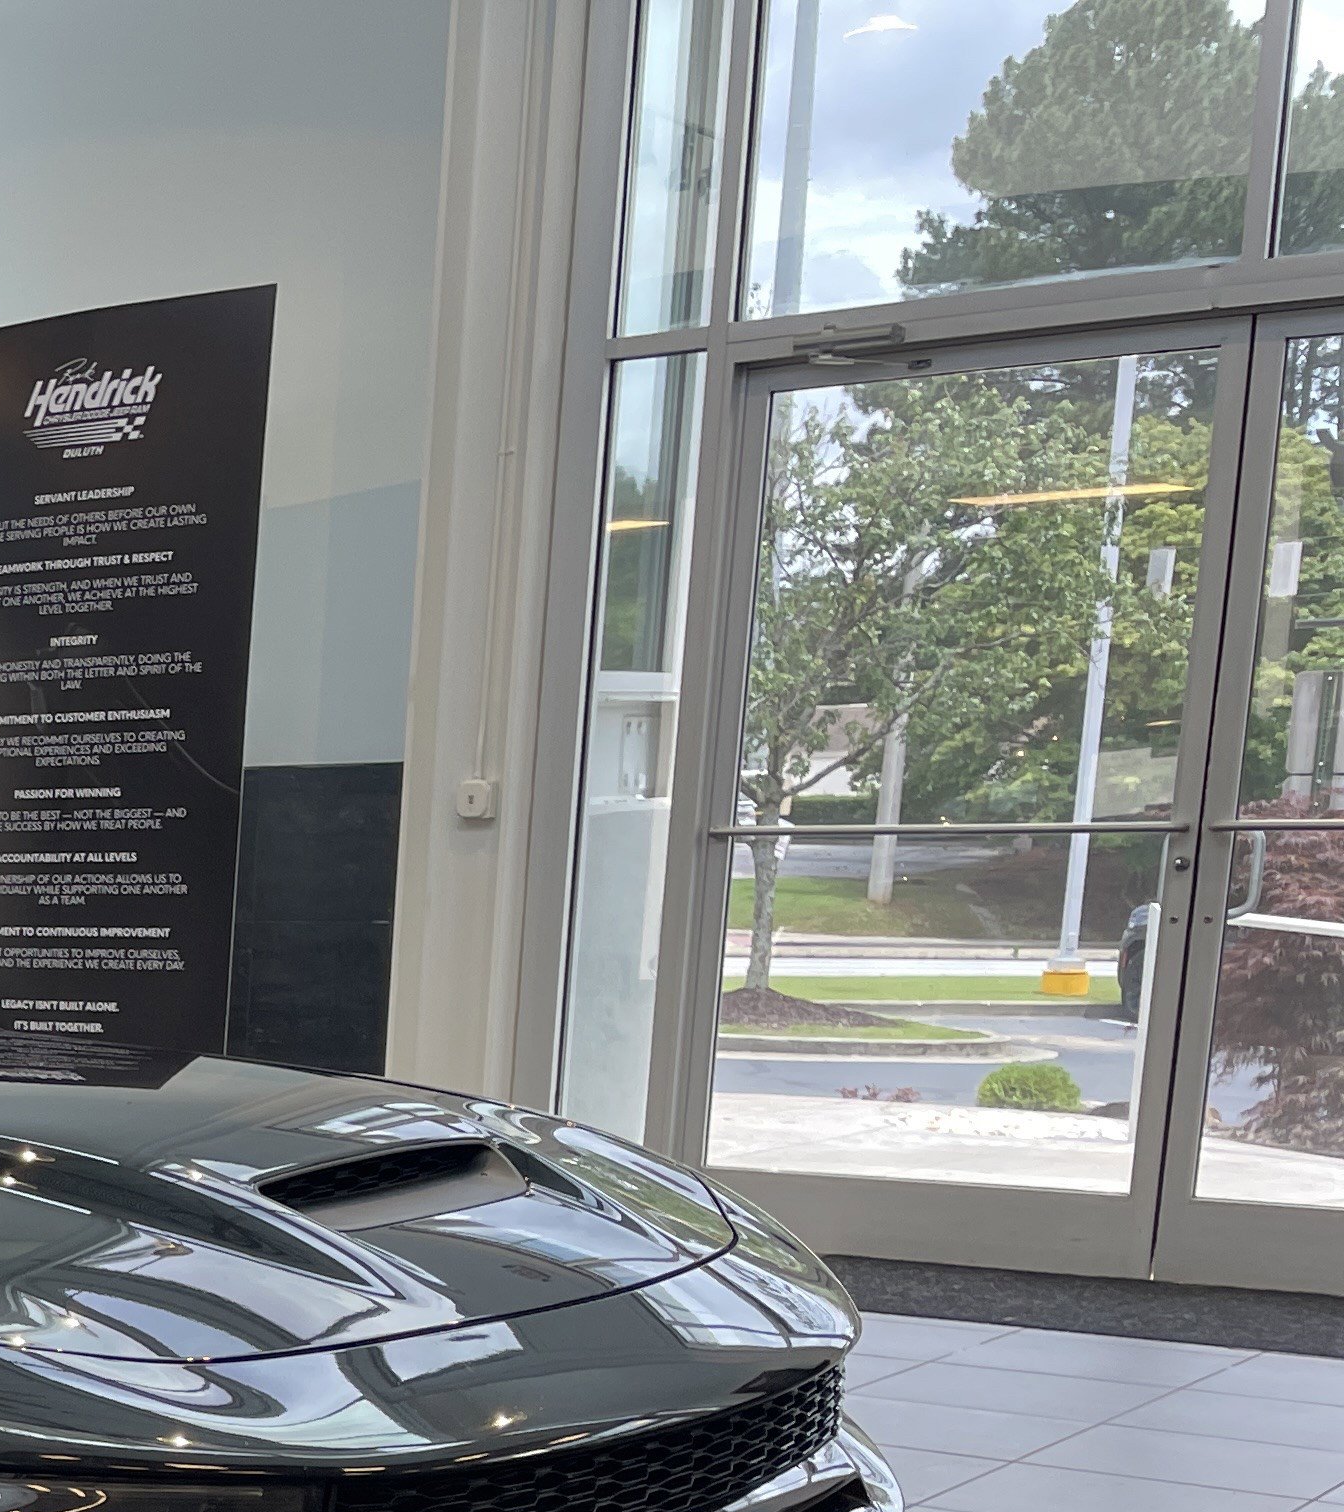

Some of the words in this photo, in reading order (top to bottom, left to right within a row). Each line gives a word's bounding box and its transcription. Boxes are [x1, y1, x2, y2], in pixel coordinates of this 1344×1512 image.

[24, 365, 163, 428] Hendrick
[62, 445, 105, 459] DULUTH
[34, 491, 76, 505] SERVANT
[77, 486, 135, 502] LEADERSHIP
[11, 518, 26, 530] THE
[27, 515, 54, 529] NEEDS
[56, 513, 70, 526] OF
[70, 510, 106, 524] OTHERS
[108, 507, 143, 521] BEFORE
[145, 505, 167, 518] OUR
[169, 503, 196, 515] OWN
[5, 528, 41, 542] SERVING
[43, 525, 75, 538] PEOPLE
[76, 524, 85, 535] IS
[86, 521, 112, 534] HOW
[113, 520, 128, 532] WE
[130, 517, 166, 531] CREATE
[167, 513, 207, 528] LASTING
[44, 557, 91, 571] THROUGH
[93, 554, 122, 567] TRUST
[123, 554, 130, 565] &
[131, 551, 174, 564] RESPECT
[14, 585, 22, 595] IS
[70, 579, 91, 590] AND
[92, 577, 122, 589] WHEN
[123, 576, 139, 587] WE
[140, 574, 169, 586] TRUST
[170, 572, 192, 584] AND
[2, 596, 22, 607] ONE
[67, 591, 83, 602] WE
[83, 588, 123, 601] ACHIEVE
[124, 587, 137, 598] AT
[138, 586, 156, 597] THE
[157, 583, 199, 596] HIGHEST
[39, 603, 63, 615] LEVEL
[50, 635, 98, 647] INTEGRITY
[41, 659, 61, 670] AND
[138, 652, 171, 665] DOING
[174, 651, 192, 663] THE
[9, 671, 39, 682] WITHIN
[40, 669, 64, 681] BOTH
[66, 668, 83, 679] THE
[84, 666, 115, 678] LETTER
[116, 665, 137, 677] AND
[139, 664, 166, 676] SPIRIT
[168, 663, 182, 674] OF
[184, 662, 202, 674] THE
[40, 713, 53, 724] TO
[54, 711, 106, 723] CUSTOMER
[107, 709, 170, 721] ENTHUSIASM
[6, 737, 20, 747] WE
[21, 735, 69, 746] RECOMMIT
[70, 733, 121, 745] OURSELVES
[123, 732, 136, 743] TO
[138, 730, 186, 742] CREATING
[34, 745, 91, 757] EXPERIENCES
[92, 744, 113, 755] AND
[114, 742, 167, 754] EXCEEDING
[14, 789, 53, 799] PASSION
[55, 788, 74, 798] FOR
[75, 787, 122, 798] WINNING
[10, 811, 21, 821] BE
[22, 811, 39, 821] THE
[40, 810, 61, 820] BEST
[73, 809, 94, 820] NOT
[95, 809, 112, 819] THE
[113, 808, 153, 819] BIGGEST
[165, 807, 187, 818] AND
[4, 821, 42, 831] SUCCESS
[43, 821, 56, 831] BY
[57, 820, 82, 831] HOW
[82, 820, 98, 831] WE
[99, 819, 126, 830] TREAT
[73, 852, 87, 863] AT
[86, 852, 103, 863] ALL
[104, 852, 137, 863] LEVELS
[37, 874, 51, 884] OF
[51, 874, 72, 884] OUR
[73, 873, 114, 884] ACTIONS
[115, 873, 153, 884] ALLOWS
[153, 873, 167, 884] US
[168, 873, 182, 884] TO
[34, 885, 61, 895] WHILE
[62, 884, 119, 895] SUPPORTING
[120, 884, 141, 895] ONE
[142, 884, 188, 895] ANOTHER
[38, 895, 51, 905] AS
[51, 895, 59, 905] A
[21, 926, 35, 937] TO
[36, 926, 98, 937] CONTINUOUS
[100, 927, 171, 938] IMPROVEMENT
[3, 947, 69, 958] OPPORTUNITIES
[71, 948, 84, 958] TO
[85, 948, 125, 959] IMPROVE
[16, 958, 31, 968] THE
[32, 958, 83, 969] EXPERIENCE
[84, 959, 99, 969] WE
[101, 959, 135, 970] CREATE
[136, 959, 164, 970] EVERY
[1, 999, 34, 1010] LEGACY
[35, 1000, 58, 1011] ISN'T
[59, 1000, 84, 1011] BUILT
[85, 1001, 120, 1012] ALONE.
[13, 1020, 29, 1031] IT'S
[29, 1020, 54, 1032] BUILT
[55, 1021, 104, 1033] TOGETHER.
